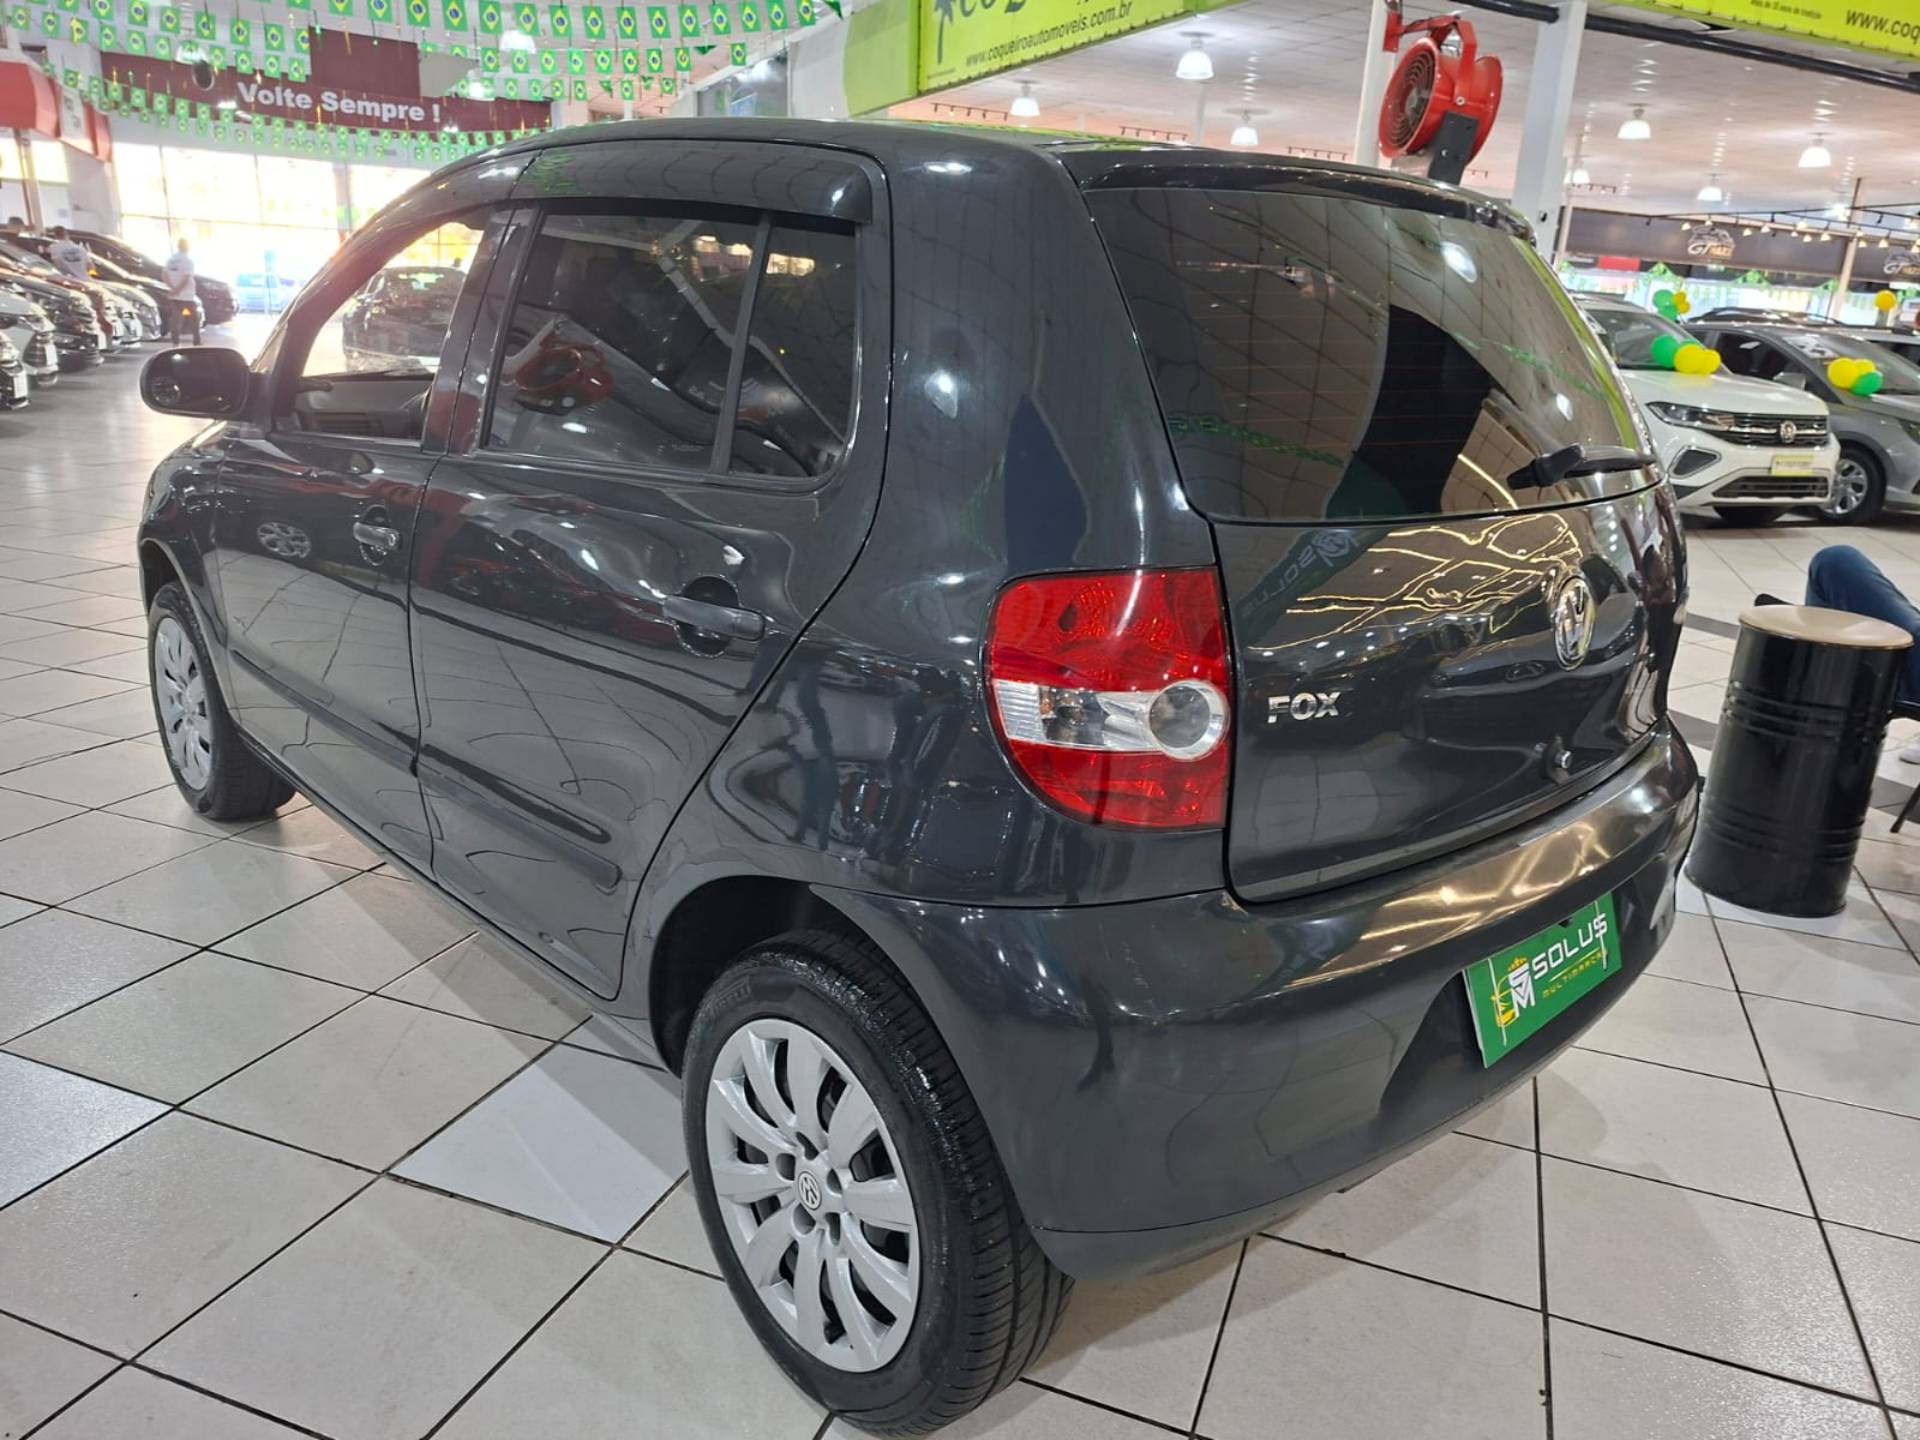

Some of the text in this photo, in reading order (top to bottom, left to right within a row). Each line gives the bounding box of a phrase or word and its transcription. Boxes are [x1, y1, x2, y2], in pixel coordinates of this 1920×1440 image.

[237, 82, 313, 110] Volte
[320, 91, 425, 122] Sempre
[1267, 691, 1341, 724] FOX
[1532, 912, 1608, 980] SOLUS
